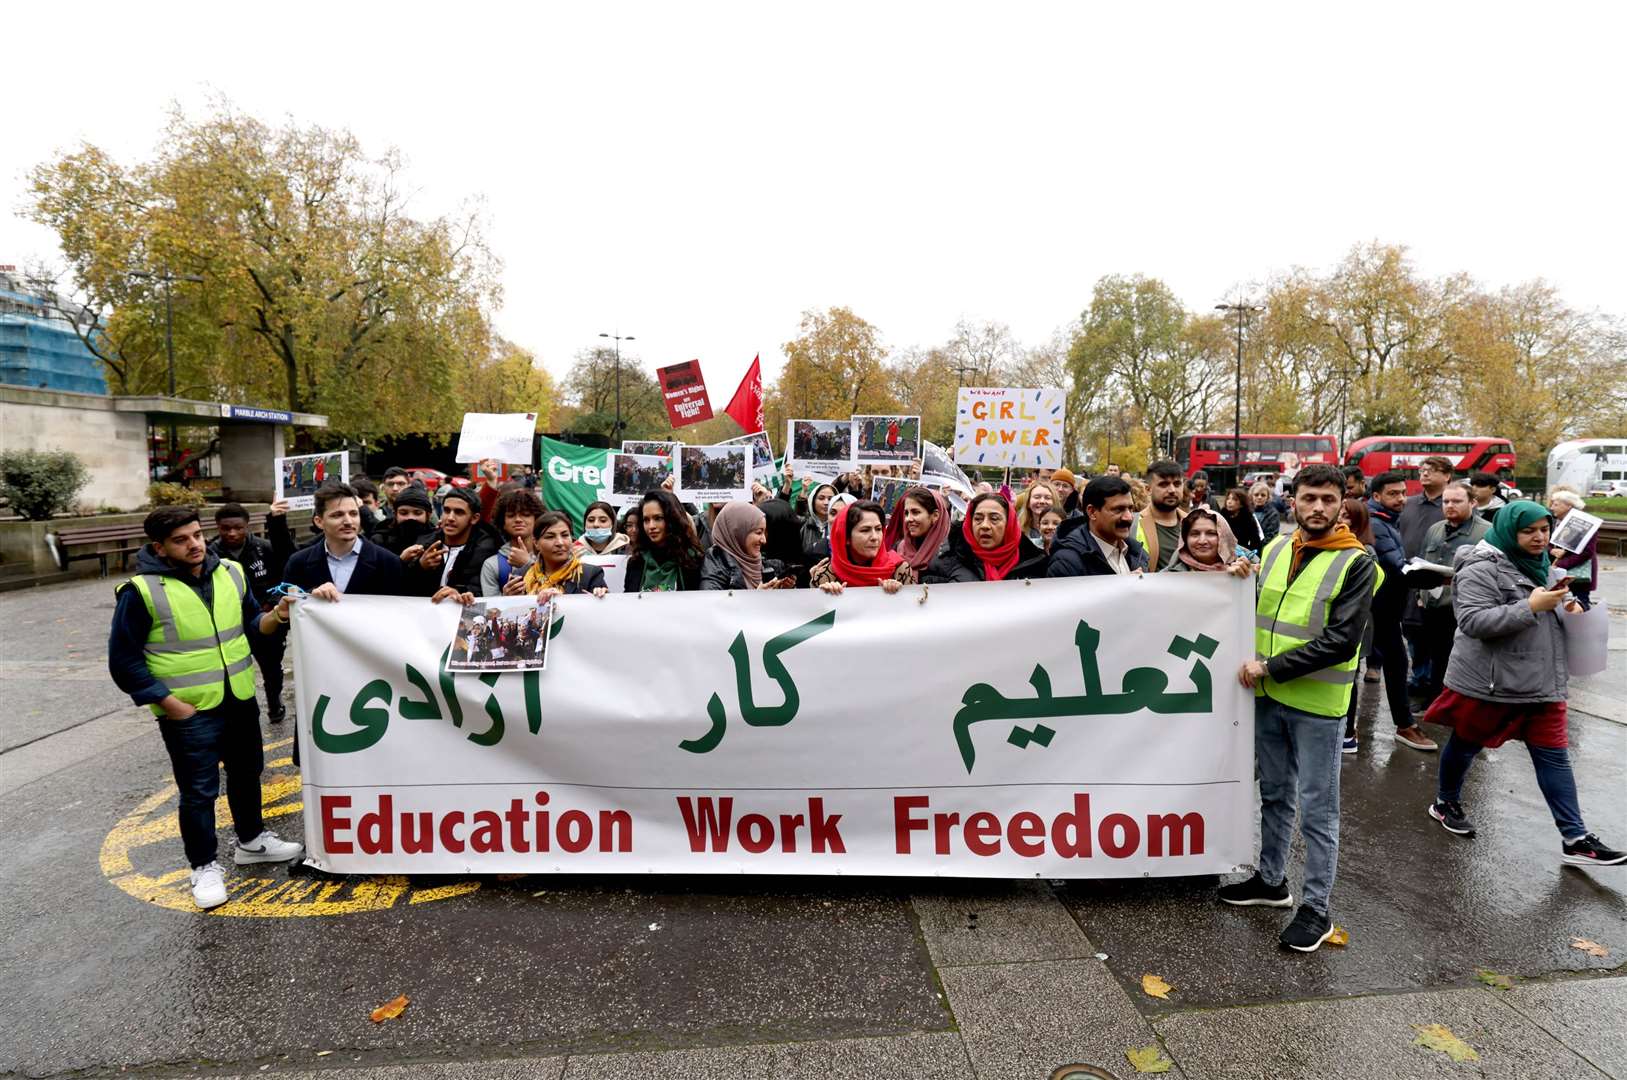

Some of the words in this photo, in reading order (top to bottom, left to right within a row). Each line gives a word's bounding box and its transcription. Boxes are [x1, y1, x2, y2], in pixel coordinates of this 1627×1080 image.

[234, 408, 254, 417] MARBLE
[255, 410, 268, 418] ARCH
[268, 411, 288, 421] STATION
[972, 401, 1036, 420] GIRL
[975, 428, 1050, 447] POWER
[321, 791, 633, 855] Education
[677, 795, 846, 854] Work
[894, 793, 1205, 859] Freedom
